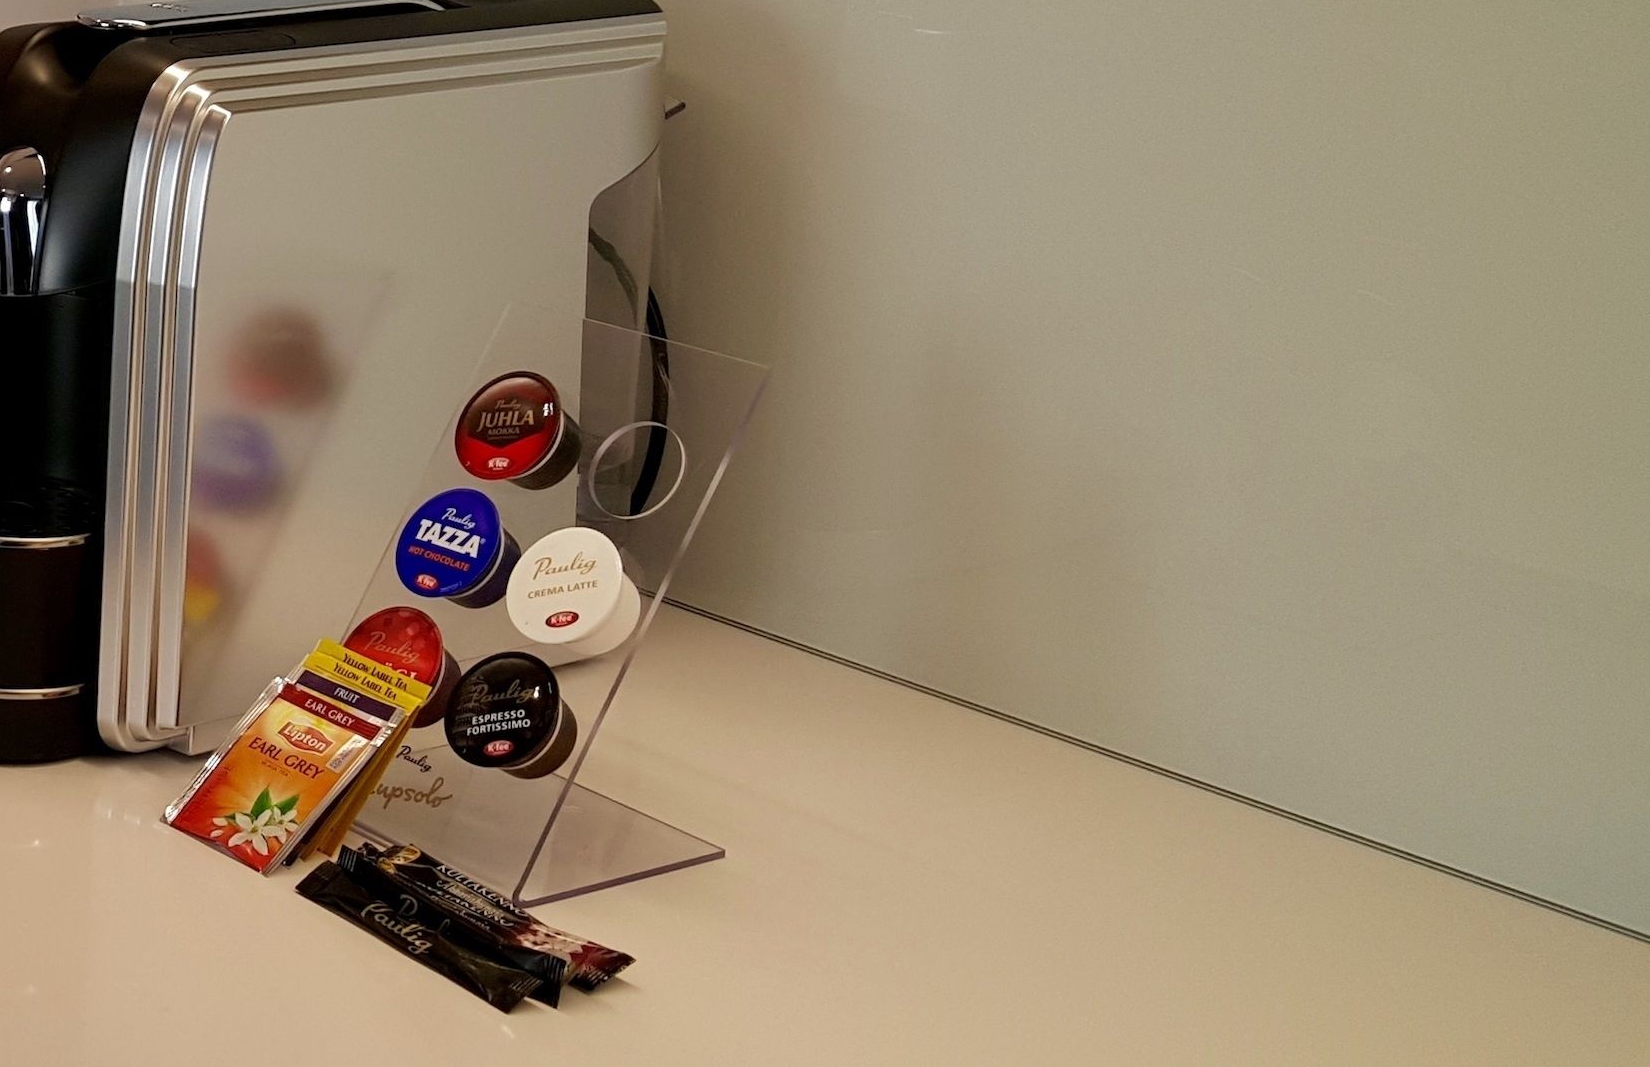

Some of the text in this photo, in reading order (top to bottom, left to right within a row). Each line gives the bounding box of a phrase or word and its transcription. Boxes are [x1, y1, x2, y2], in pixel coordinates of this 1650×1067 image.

[476, 409, 535, 433] JUHLA
[441, 507, 477, 530] Paulig
[408, 544, 470, 572] HOT CHOCOLATE
[533, 551, 597, 581] Paulig
[527, 579, 598, 599] CREMA LATTE
[363, 631, 421, 663] Paulig
[333, 662, 398, 701] YELLOW LABEL TEA
[342, 653, 372, 673] YELLOW
[371, 666, 395, 684] LABEL
[394, 678, 409, 692] TEA
[334, 687, 360, 704] FRUIT
[471, 679, 535, 708] Paulig
[304, 699, 356, 727] EARL GREY
[471, 709, 526, 726] ESPRESSO
[284, 724, 328, 752] Lipton
[466, 719, 531, 737] FORTISSIMO
[248, 737, 326, 780] EARL GREY
[396, 745, 432, 773] Paulig
[370, 776, 454, 810] upsolo
[360, 900, 433, 955] Paulig
